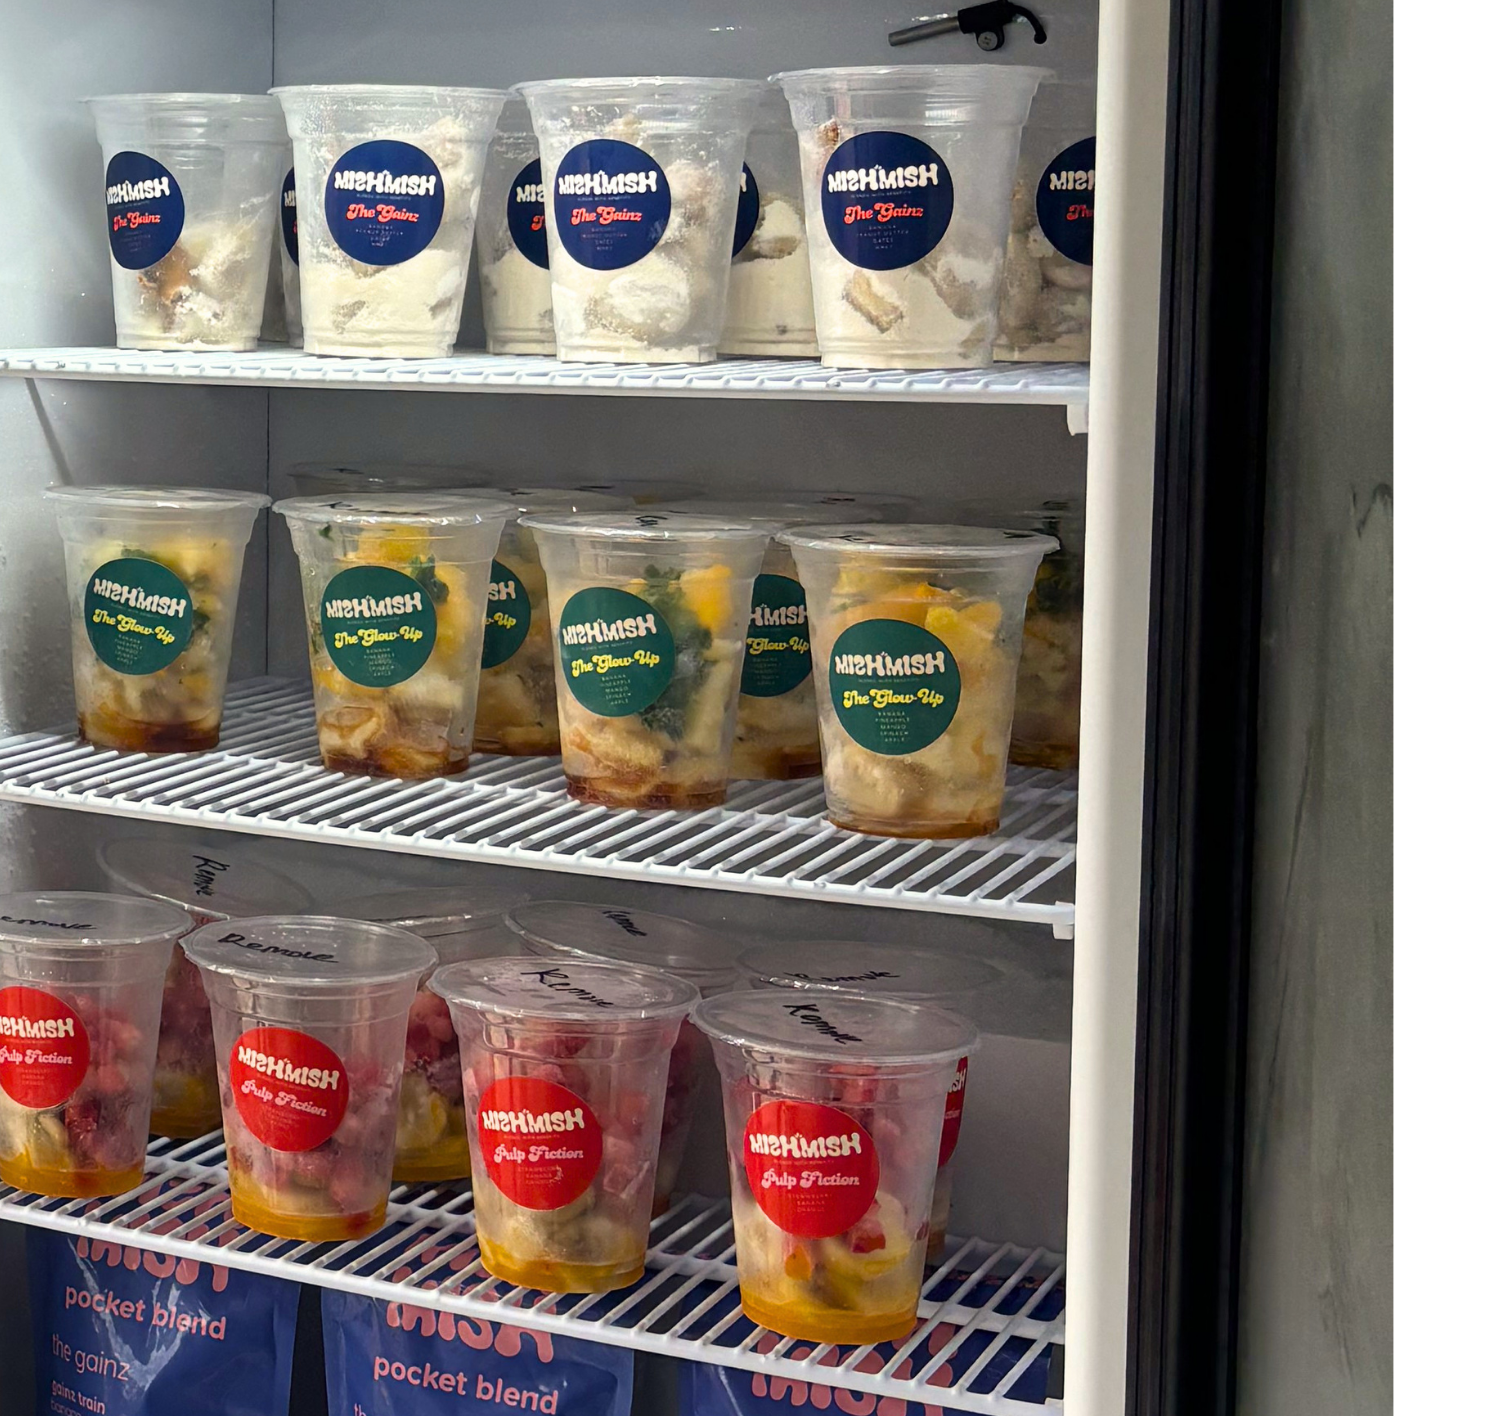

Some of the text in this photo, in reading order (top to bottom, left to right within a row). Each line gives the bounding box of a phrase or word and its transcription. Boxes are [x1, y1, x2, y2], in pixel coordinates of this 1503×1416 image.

[334, 169, 436, 196] MISHMISH
[558, 170, 657, 195] MISHMISH
[827, 163, 938, 193] MISHMISH
[113, 212, 161, 232] The Gainz
[346, 204, 419, 223] The Gainz
[570, 206, 642, 226] The Gainz
[843, 202, 924, 224] The Gainz
[93, 578, 186, 618] MISHMISH
[325, 591, 422, 618] MISHMISH
[93, 609, 116, 625] The
[117, 614, 175, 645] Glow-Up
[334, 626, 423, 649] The Glow-Up
[562, 614, 657, 645] MISHMISH
[571, 650, 660, 677] The Glow-Up
[835, 651, 945, 677] MISHMISH
[843, 687, 945, 708] The Glow-Up
[217, 933, 339, 963] Remove
[24, 1049, 73, 1064] Fiction
[238, 1045, 340, 1090] MISHMISH
[241, 1079, 273, 1102] Pulp
[274, 1091, 327, 1117] Fiction
[482, 1107, 585, 1133] MISHMISH
[493, 1143, 584, 1164] Pulp Fiction
[749, 1132, 862, 1158] MISHMISH
[761, 1168, 860, 1190] Pulp Fiction
[65, 1286, 226, 1340] pocket blend
[52, 1334, 130, 1381] the gainz
[52, 1380, 106, 1415] gainz train
[373, 1355, 559, 1415] pocket blend
